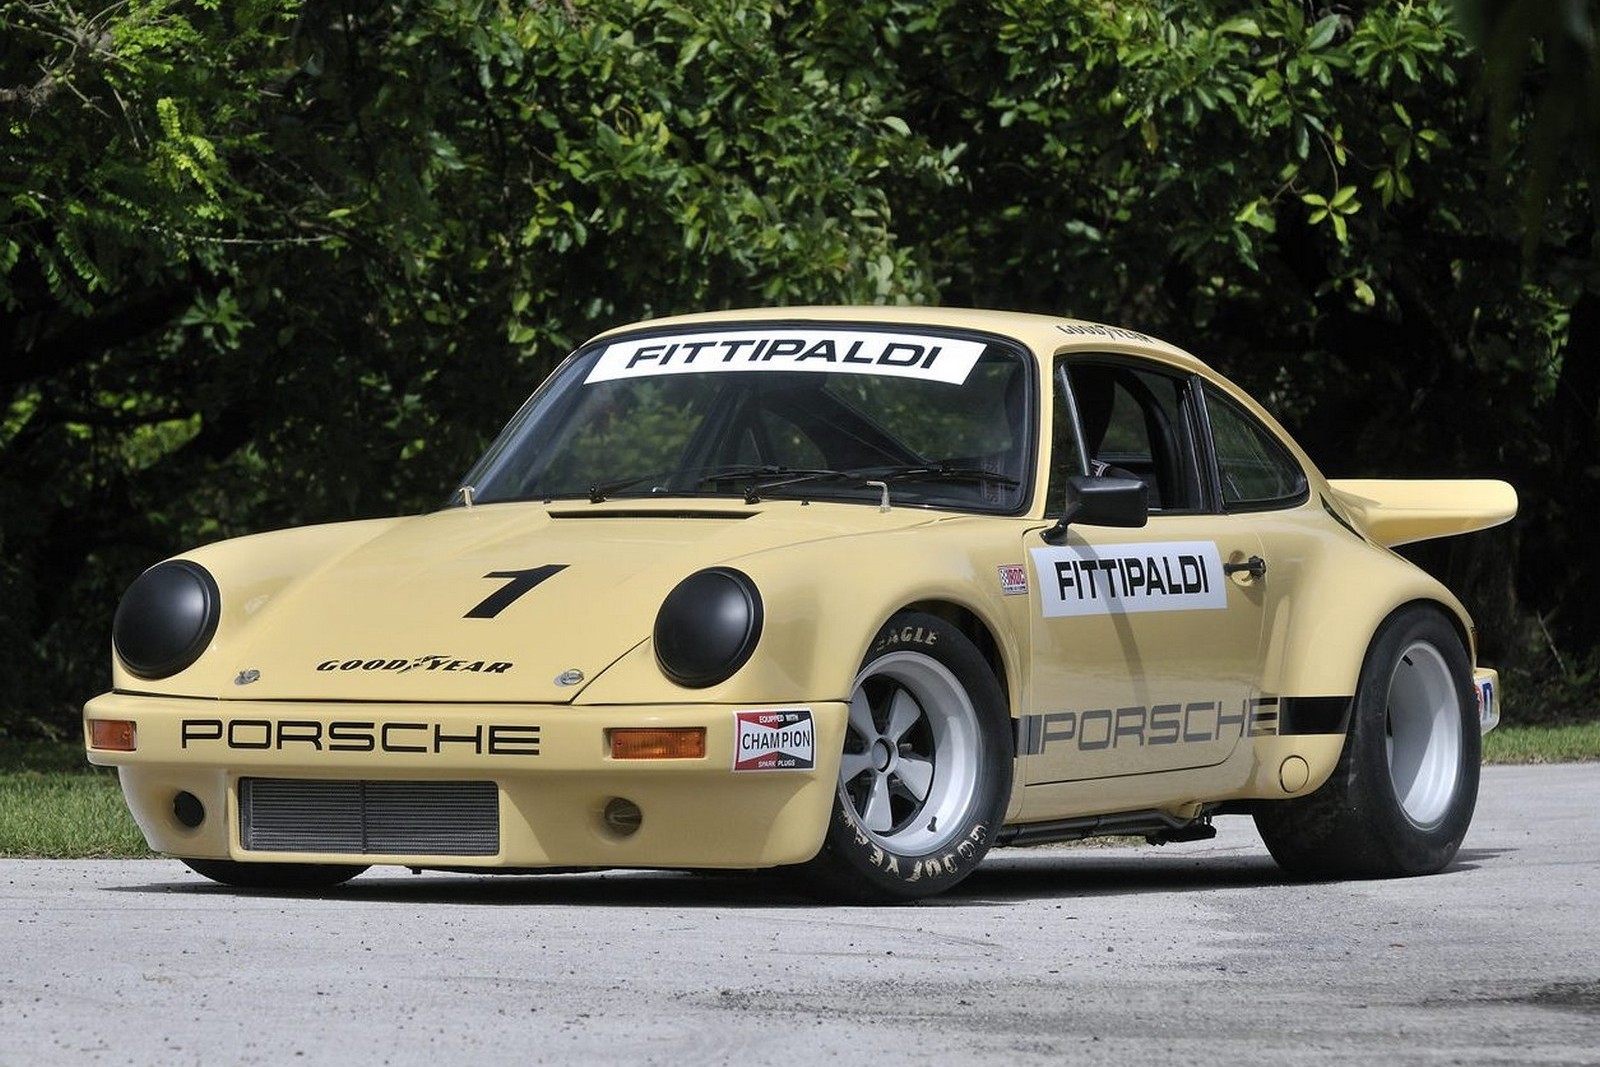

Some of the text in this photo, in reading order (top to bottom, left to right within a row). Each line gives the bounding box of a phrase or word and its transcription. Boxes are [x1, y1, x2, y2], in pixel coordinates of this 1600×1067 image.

[625, 339, 942, 369] FITTIPALDI
[462, 564, 571, 618] 1
[1055, 555, 1209, 600] FITTIPALDI
[759, 715, 784, 723] EQUIPPED
[1040, 697, 1278, 755] PORSCHE
[182, 720, 540, 755] PORSCHE
[742, 730, 810, 750] CHAMPION
[777, 759, 796, 767] PLUGS
